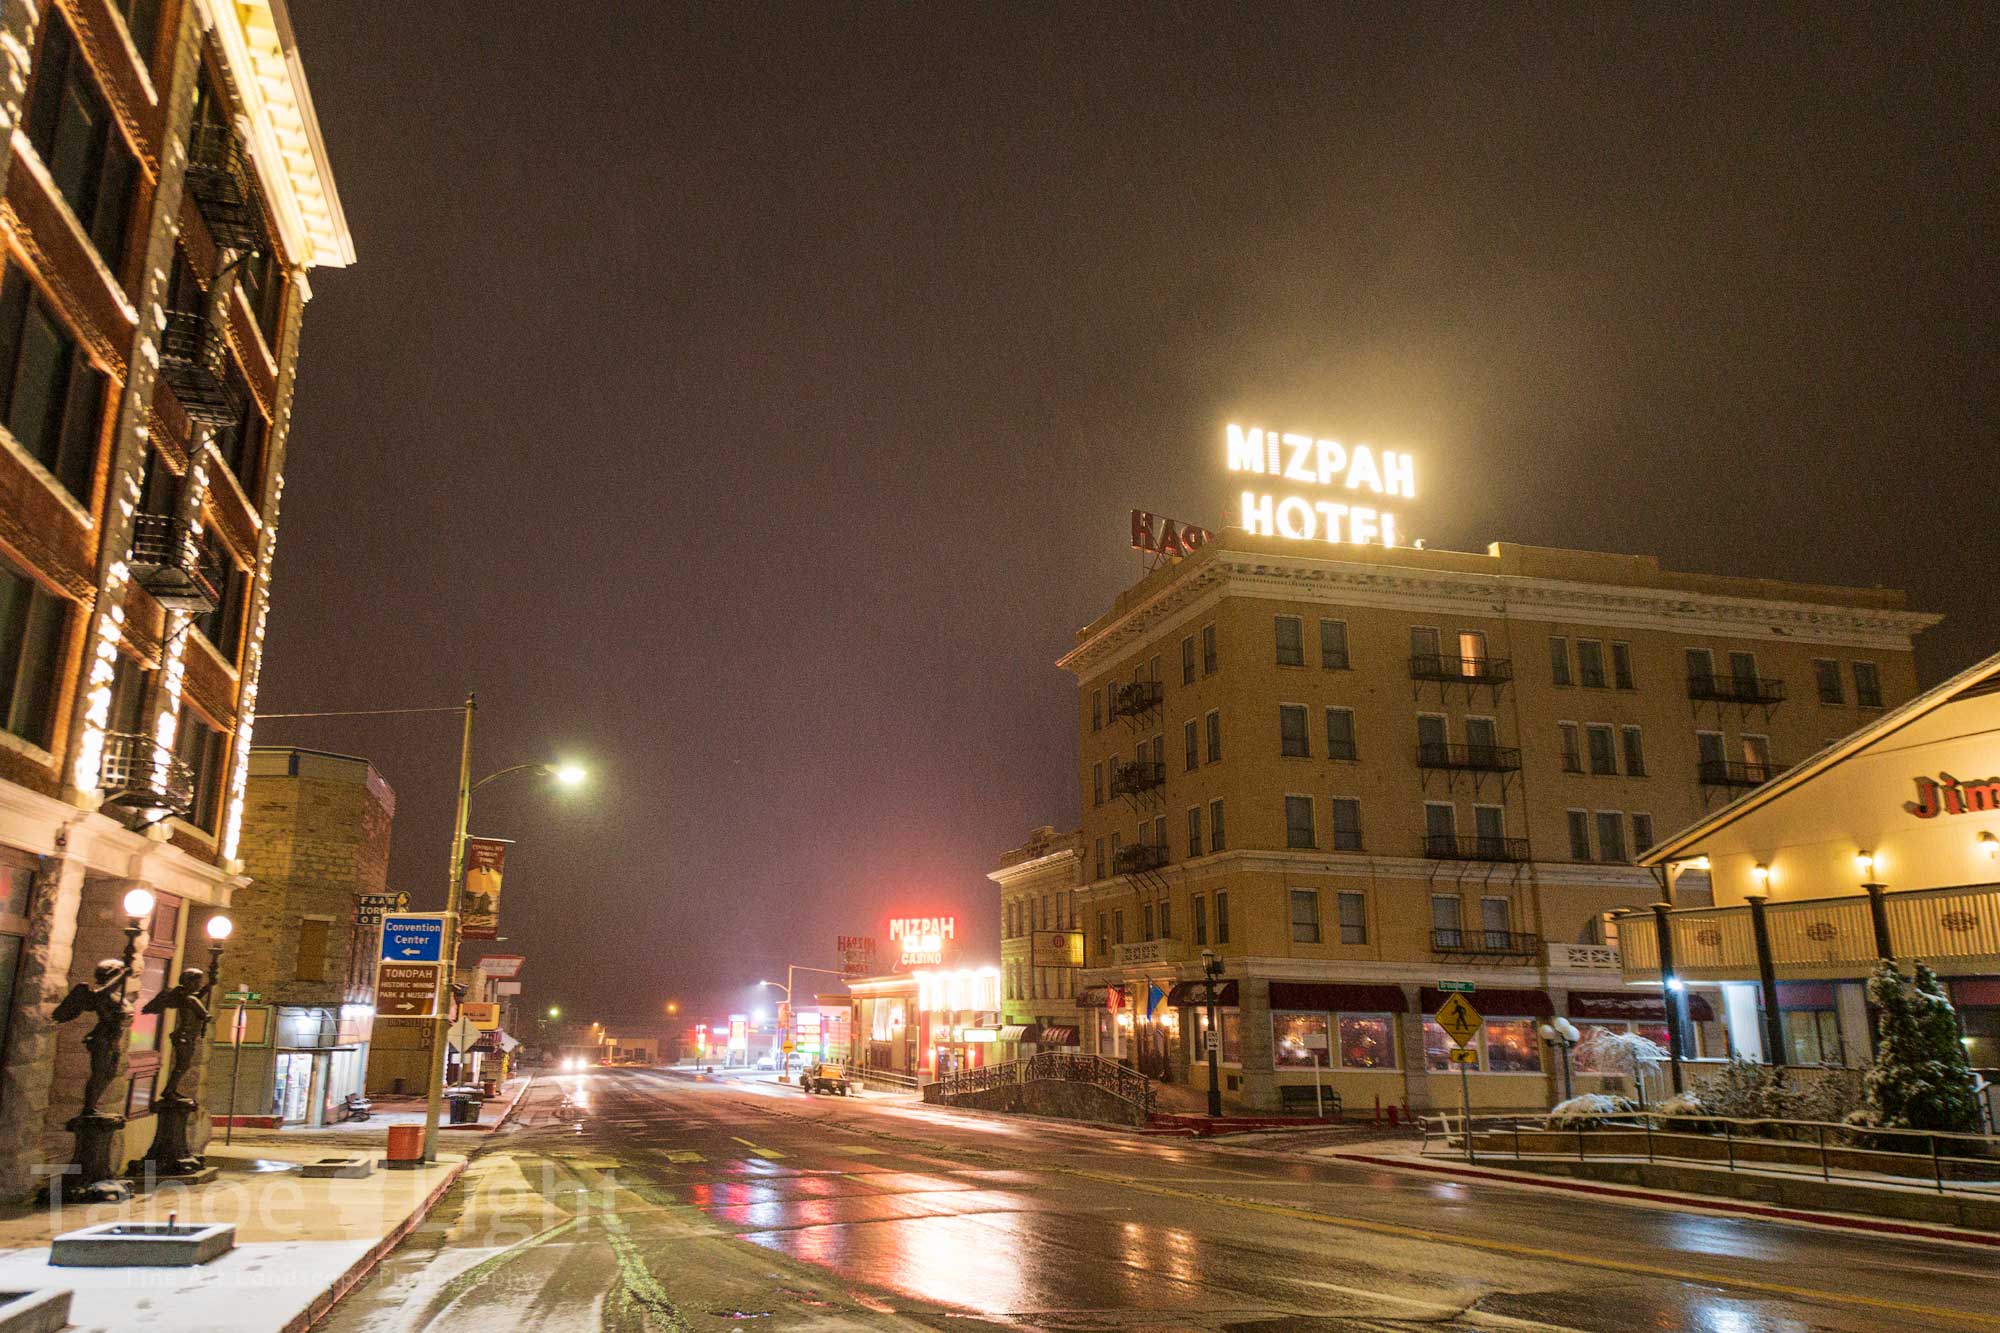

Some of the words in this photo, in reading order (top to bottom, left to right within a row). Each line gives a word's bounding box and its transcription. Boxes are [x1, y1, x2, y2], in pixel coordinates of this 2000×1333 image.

[1226, 424, 1415, 498] MIZPAH
[1241, 491, 1396, 548] HOTEL
[386, 922, 441, 932] Convention
[889, 917, 954, 941] MIZPAH
[394, 935, 430, 945] Center
[901, 952, 942, 965] CASINO
[385, 969, 433, 978] TONOPAH
[381, 981, 411, 989] HISTORIC
